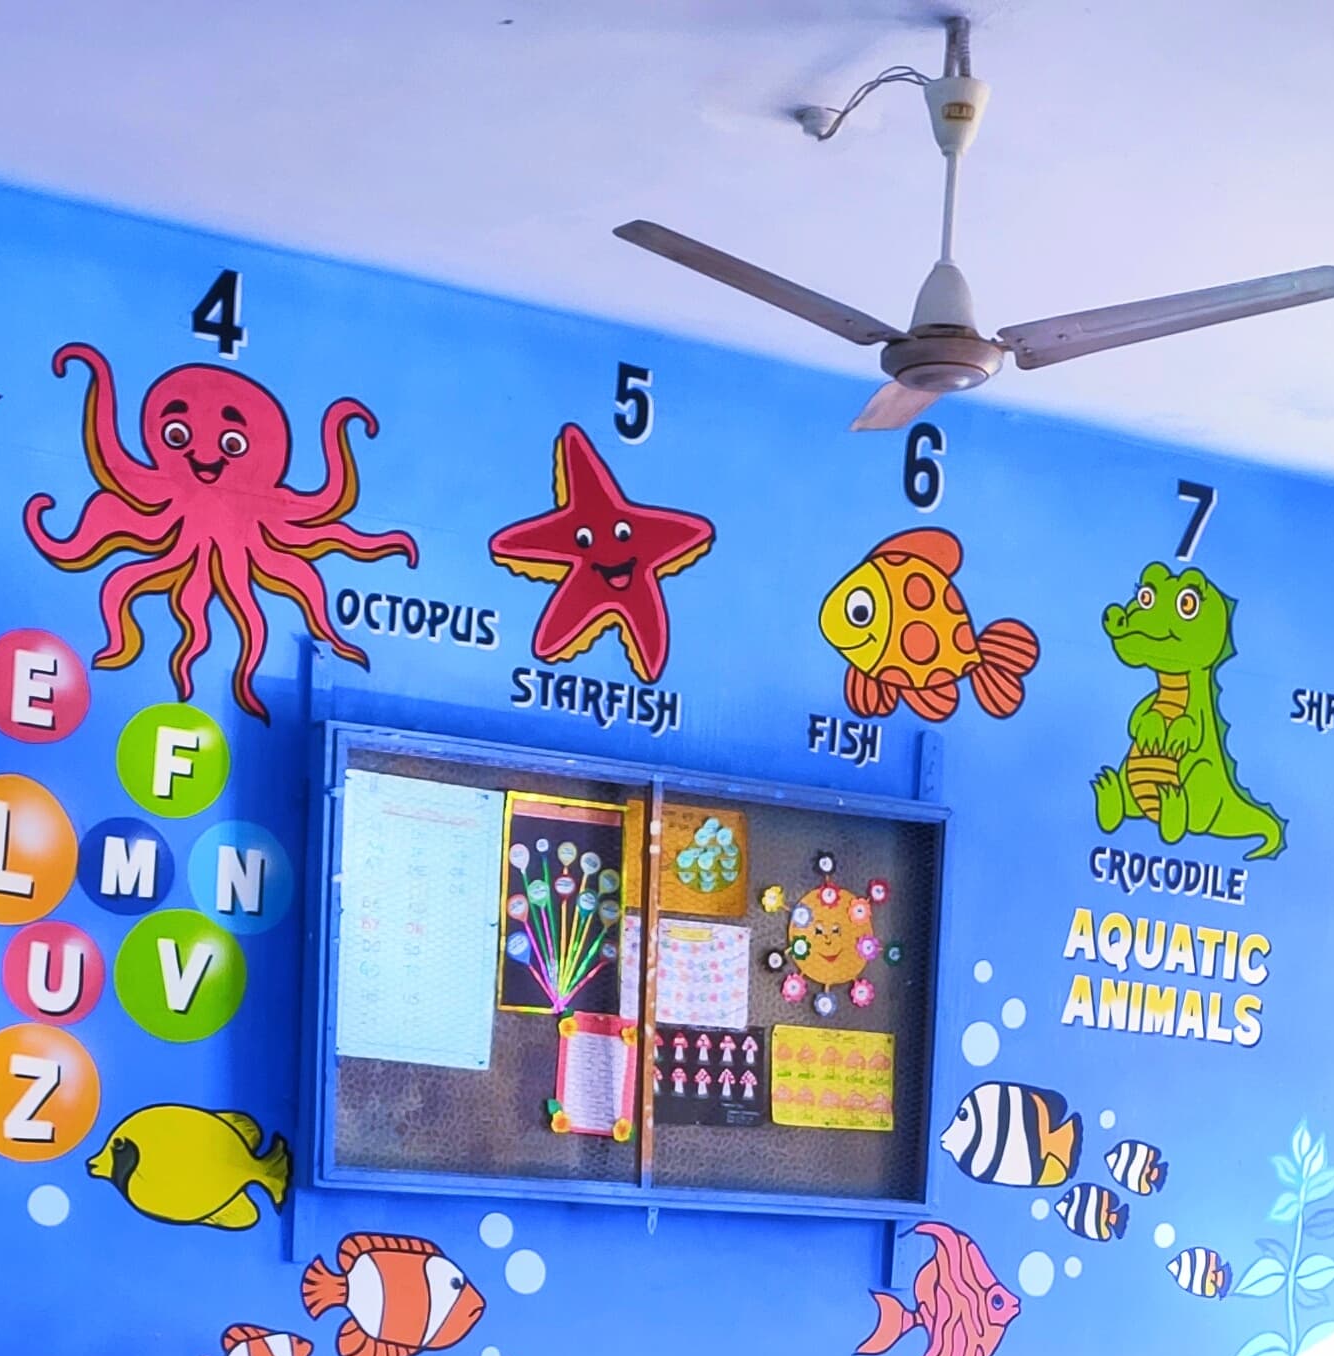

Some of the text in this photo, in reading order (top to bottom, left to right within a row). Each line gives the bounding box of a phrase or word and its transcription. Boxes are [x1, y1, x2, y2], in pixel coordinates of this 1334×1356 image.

[190, 270, 247, 356] 4
[613, 361, 655, 444] 5
[903, 422, 947, 511] 6
[1175, 479, 1218, 561] 7
[337, 588, 499, 648] OCTOPUS
[11, 649, 59, 728] E
[152, 726, 199, 799] F
[511, 667, 681, 732] STARFISH
[808, 712, 883, 766] FISH
[101, 836, 159, 898] M
[216, 846, 265, 914] N
[1088, 846, 1248, 904] CROCODILE
[27, 941, 85, 1013] U
[157, 937, 213, 1014] V
[1062, 907, 1271, 986] AQUATIC
[1061, 974, 1263, 1048] ANIMALS
[3, 1055, 61, 1142] Z
